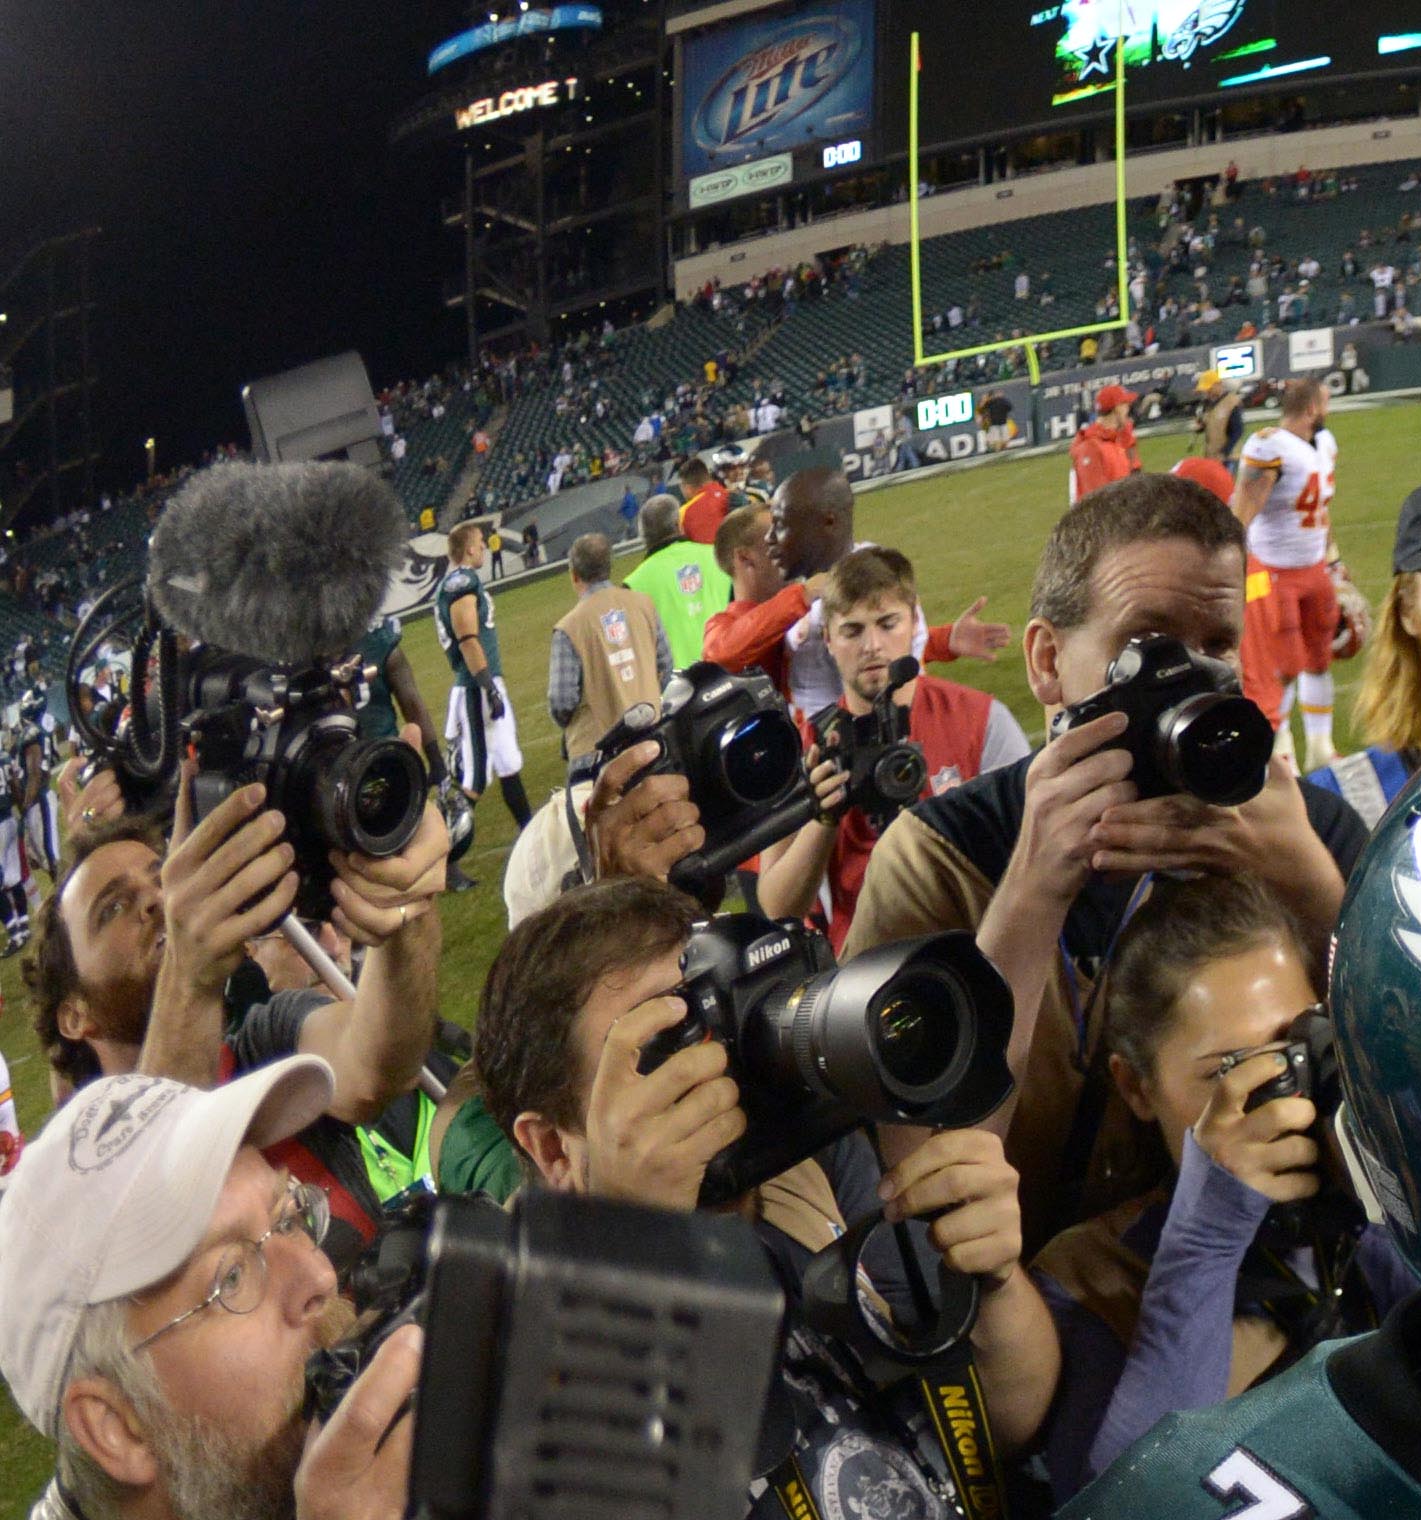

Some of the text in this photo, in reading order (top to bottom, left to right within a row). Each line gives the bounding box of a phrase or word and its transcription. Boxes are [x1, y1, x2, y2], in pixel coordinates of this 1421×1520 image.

[454, 80, 559, 129] WELCOME
[723, 42, 838, 145] Lite
[823, 140, 861, 169] 0:00
[917, 391, 973, 431] 0:00
[702, 681, 734, 702] Canon
[748, 937, 791, 966] Nikon
[939, 1385, 984, 1477] Nikon
